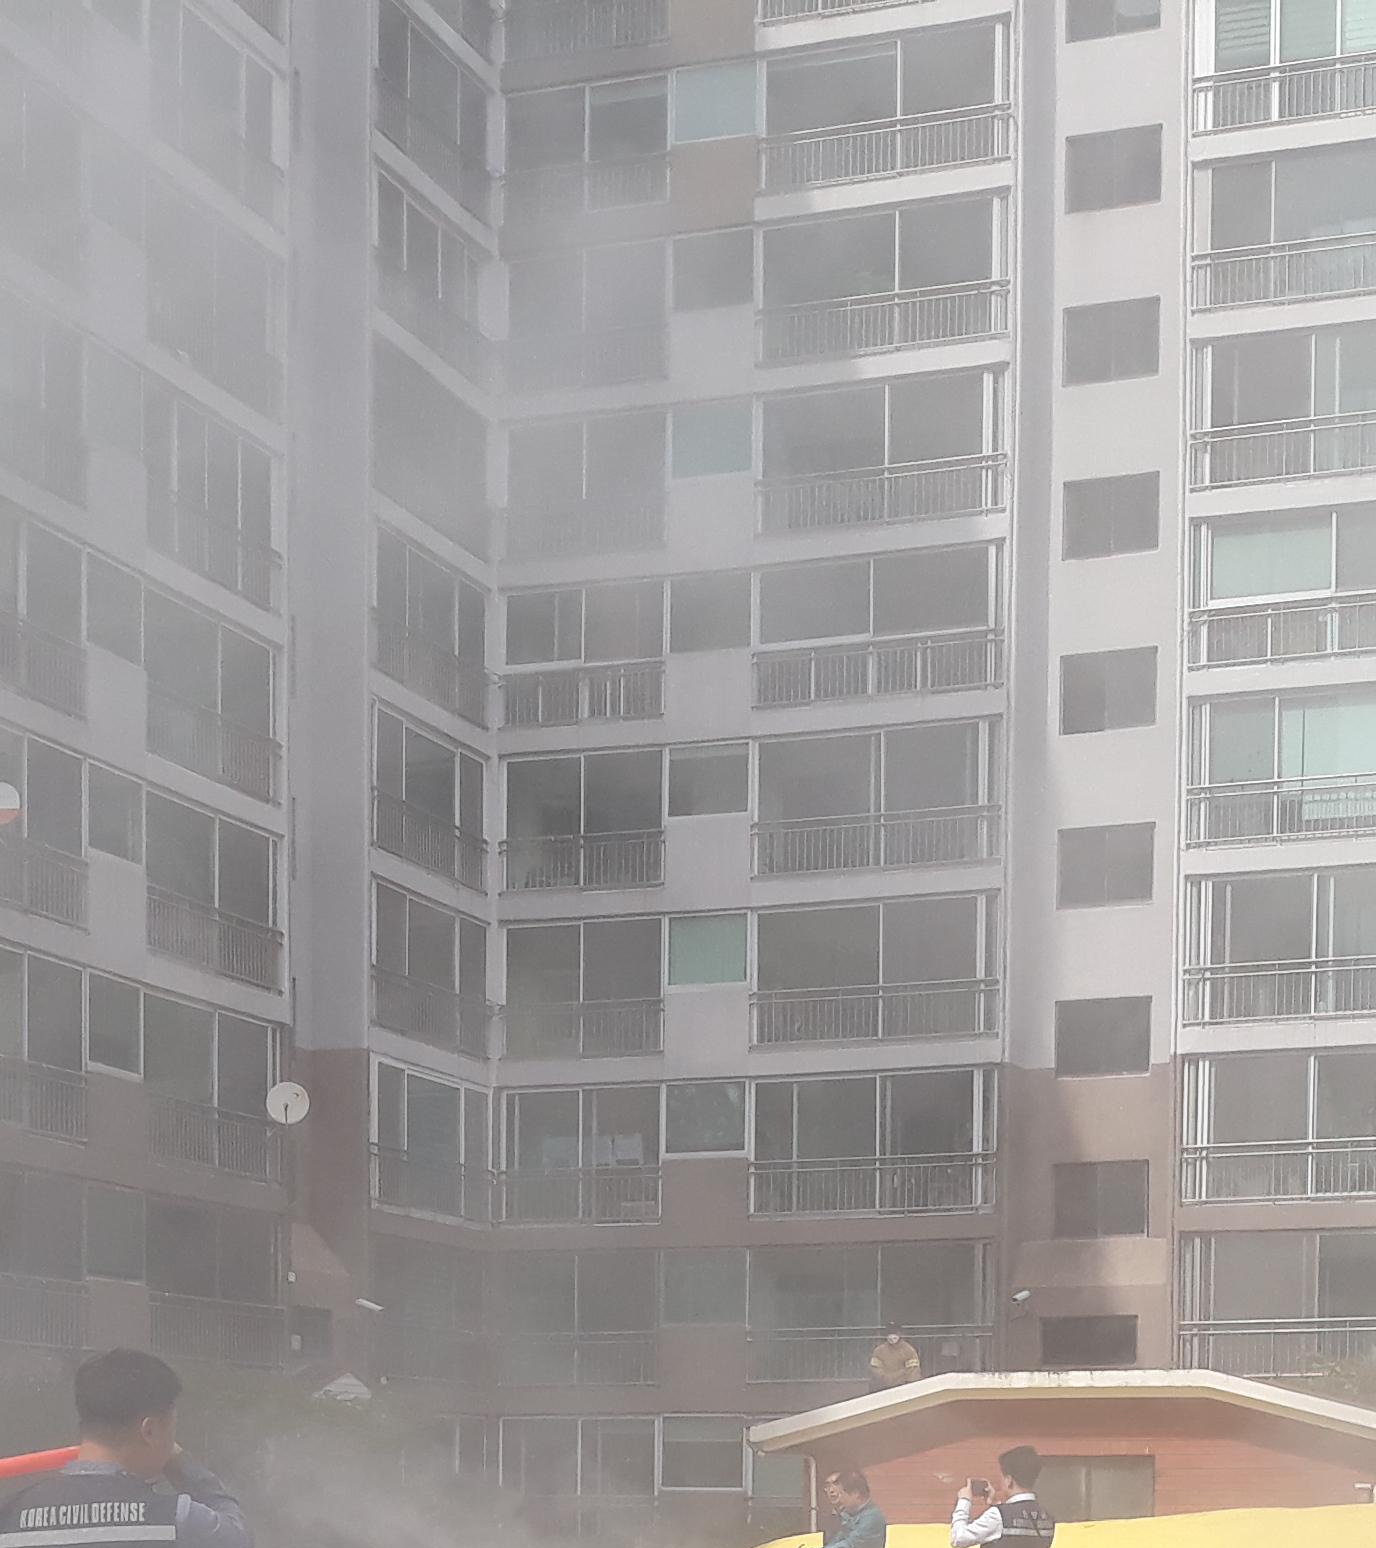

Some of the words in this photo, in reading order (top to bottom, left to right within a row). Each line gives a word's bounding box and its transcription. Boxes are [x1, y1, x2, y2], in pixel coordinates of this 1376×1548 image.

[19, 1507, 57, 1528] KOREA
[59, 1504, 90, 1525] CIVIL
[91, 1502, 145, 1523] DEFENSE
